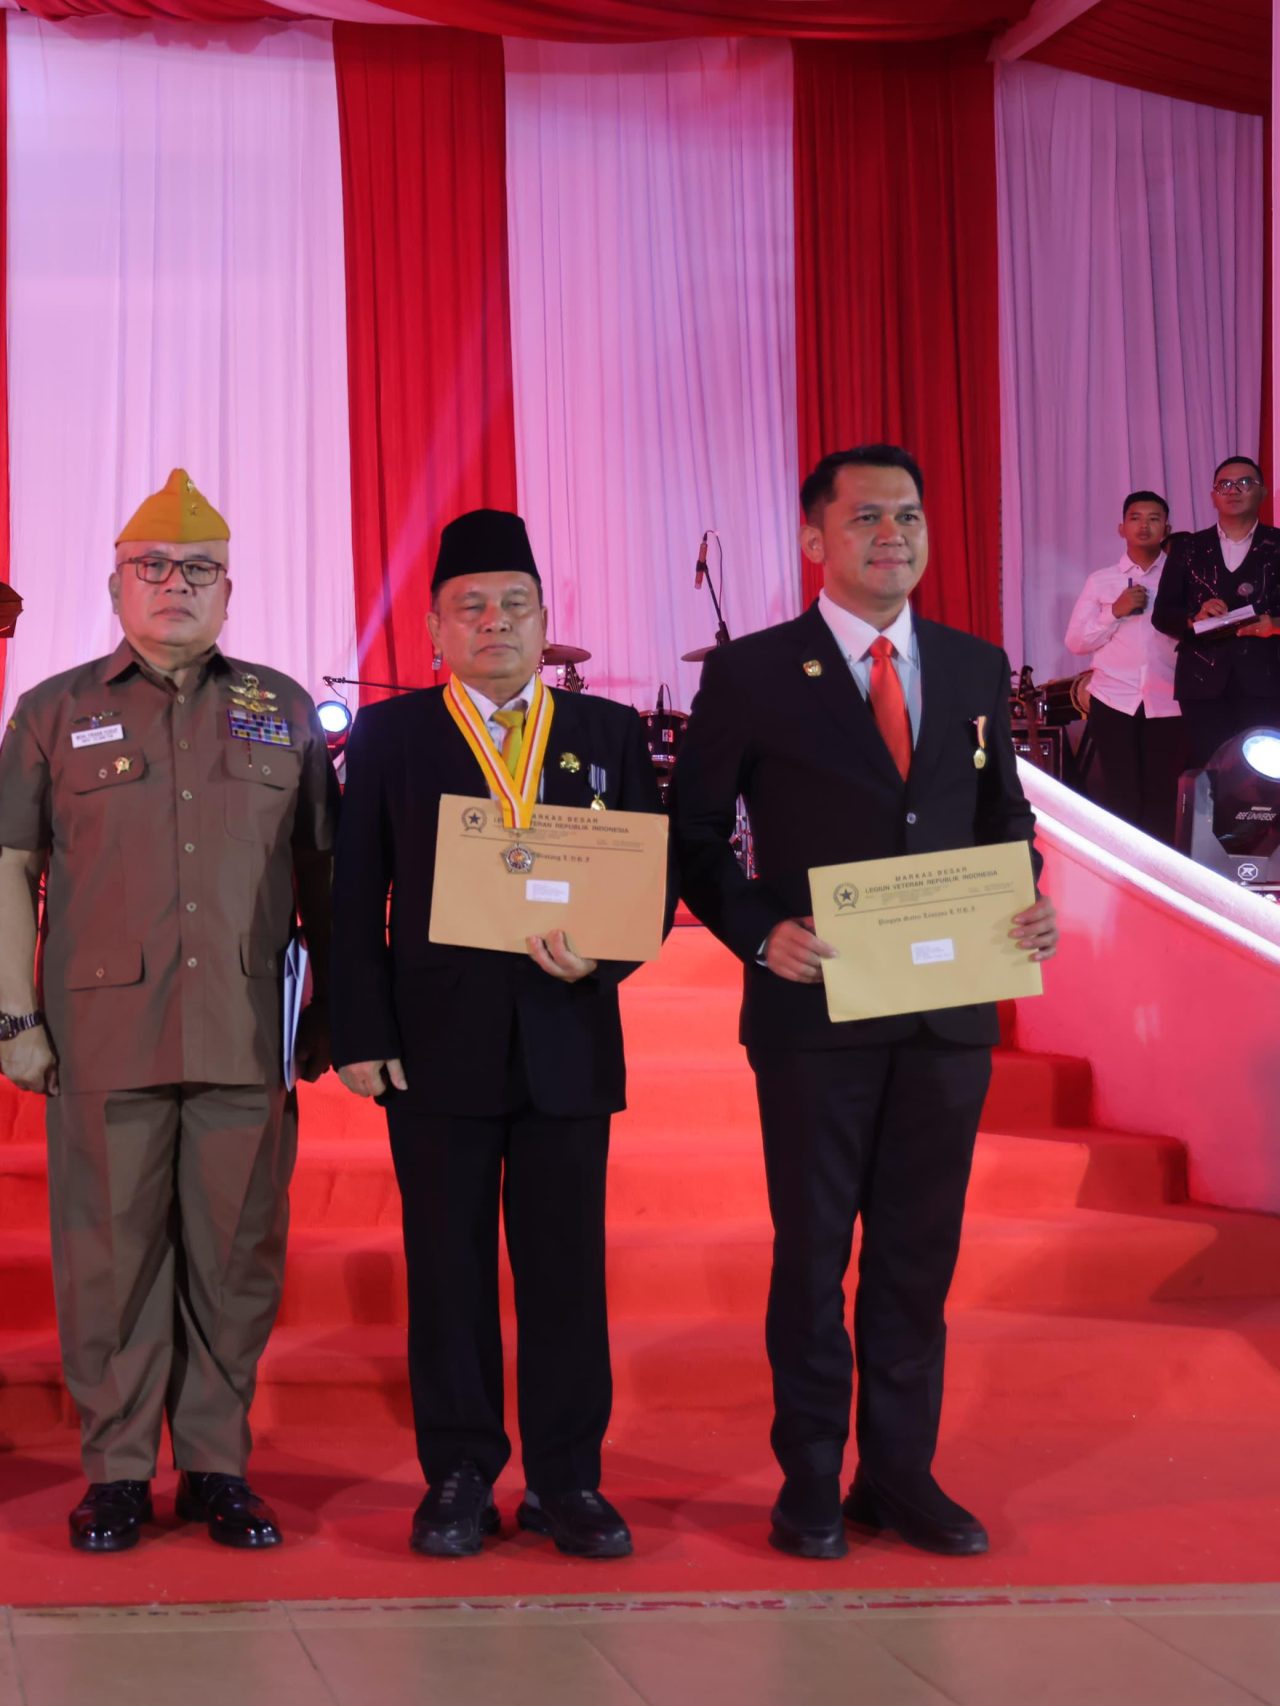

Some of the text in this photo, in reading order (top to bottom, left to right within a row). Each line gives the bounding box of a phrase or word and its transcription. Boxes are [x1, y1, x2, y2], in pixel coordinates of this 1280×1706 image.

[532, 814, 599, 825] ARKAS BESAR
[555, 821, 588, 831] REPUBLIK
[592, 825, 629, 834] INDONESIA
[895, 866, 968, 882] MARKAS BESAR
[864, 870, 998, 894] LEGIUN VETERAN REPUBLIK INDONESIA
